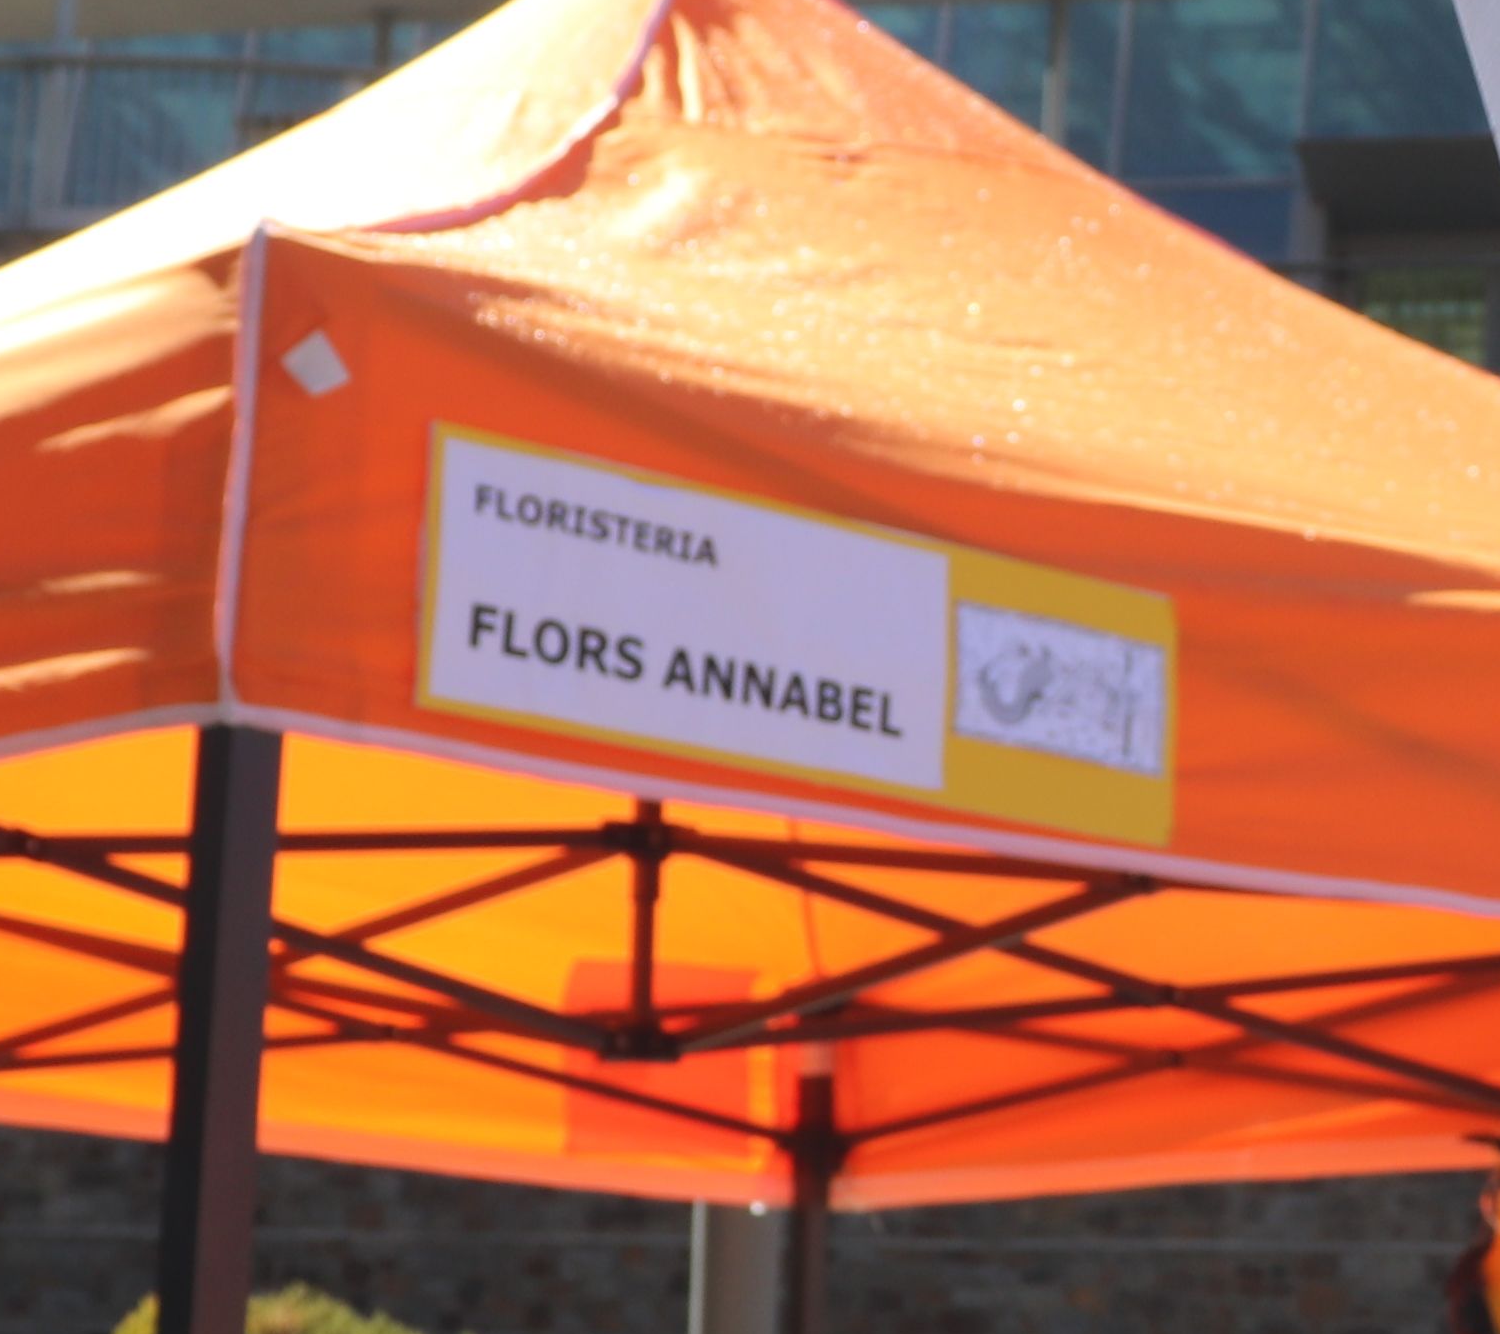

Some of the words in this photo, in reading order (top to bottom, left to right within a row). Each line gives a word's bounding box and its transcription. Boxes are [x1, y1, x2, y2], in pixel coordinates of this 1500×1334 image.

[474, 484, 718, 567] FLORISTERIA
[468, 603, 644, 682] FLORS
[663, 647, 903, 738] ANNABEL
